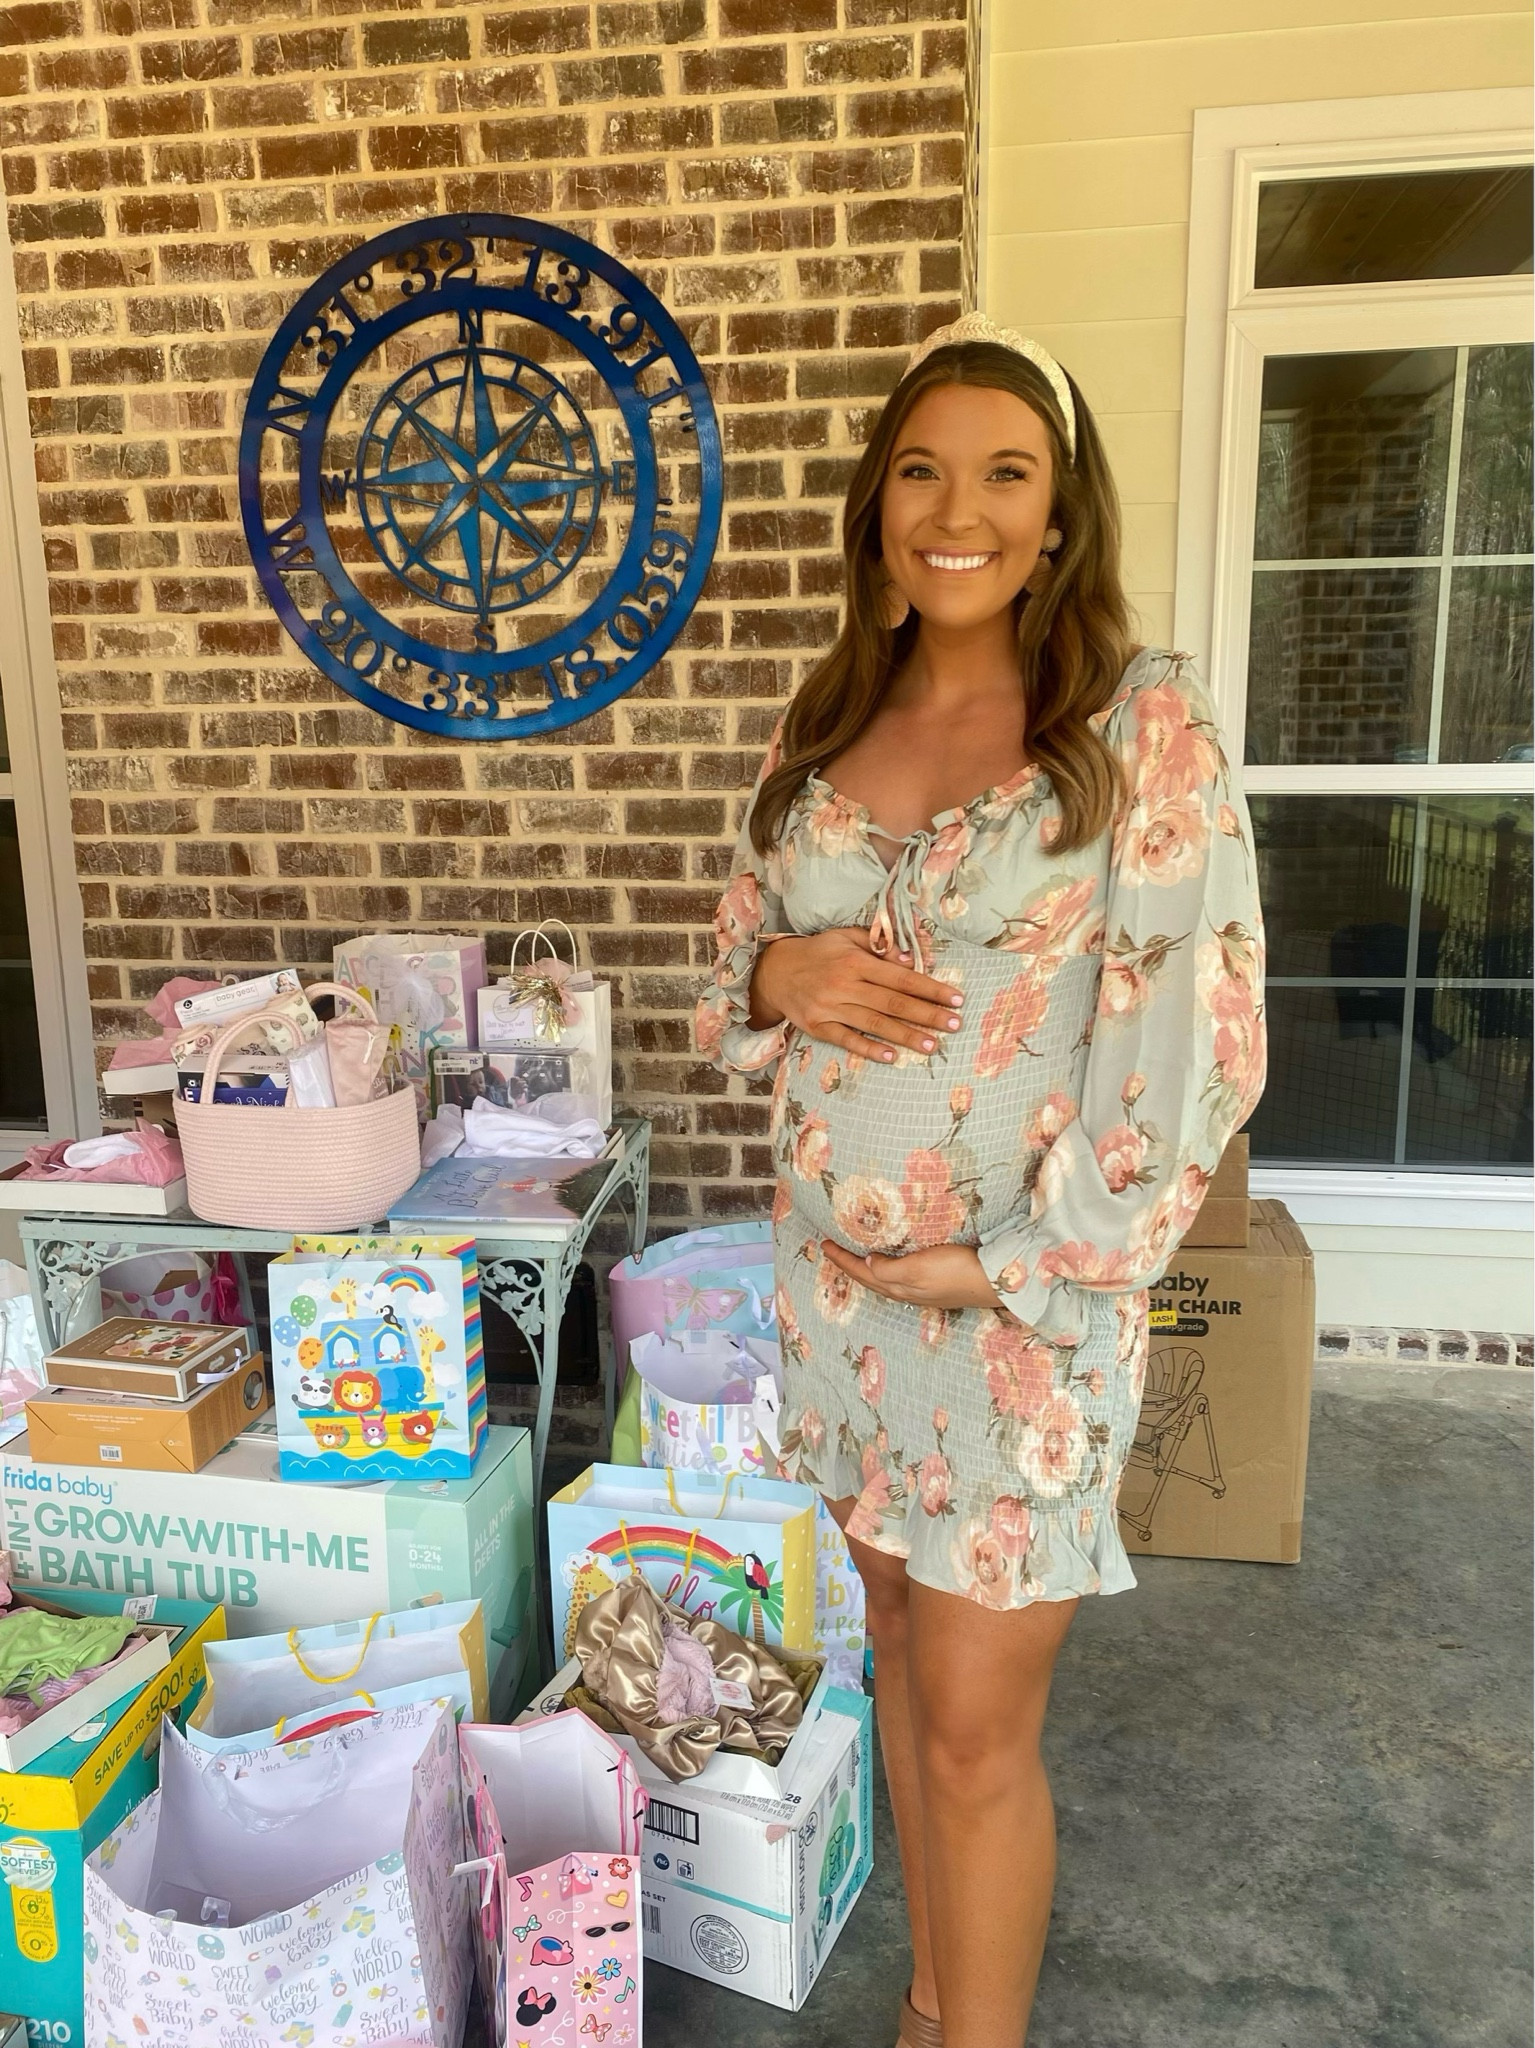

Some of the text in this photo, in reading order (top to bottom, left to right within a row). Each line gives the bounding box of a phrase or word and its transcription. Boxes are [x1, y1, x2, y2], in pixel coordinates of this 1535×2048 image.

[457, 308, 484, 343] N
[611, 459, 637, 497] E
[475, 622, 498, 654] S
[216, 991, 235, 1002] baby
[1149, 1298, 1242, 1315] GH CHAIR
[4, 1466, 112, 1505] frida baby
[5, 1498, 34, 1580] 4-IN-1
[34, 1502, 370, 1573] GROW-WITH-ME
[474, 1494, 515, 1557] ALL IN THE
[409, 1549, 442, 1563] 0-24
[39, 1546, 259, 1608] BATH TUB
[816, 1574, 861, 1614] aby
[95, 1665, 184, 1786] SAVE UP TO $500!
[784, 1792, 802, 1804] 28
[1, 1856, 55, 1870] SOFTEST
[652, 1893, 666, 1902] SET
[239, 1914, 292, 1946] WORLD
[150, 1947, 195, 1971] WORLD
[351, 1937, 399, 1965] hello
[352, 1951, 403, 1987] WORLD
[145, 1992, 192, 2012] Sweet
[360, 1997, 408, 2030] Sweet
[27, 2018, 71, 2046] 210
[150, 2008, 194, 2031] Baby
[364, 2018, 410, 2044] Baby
